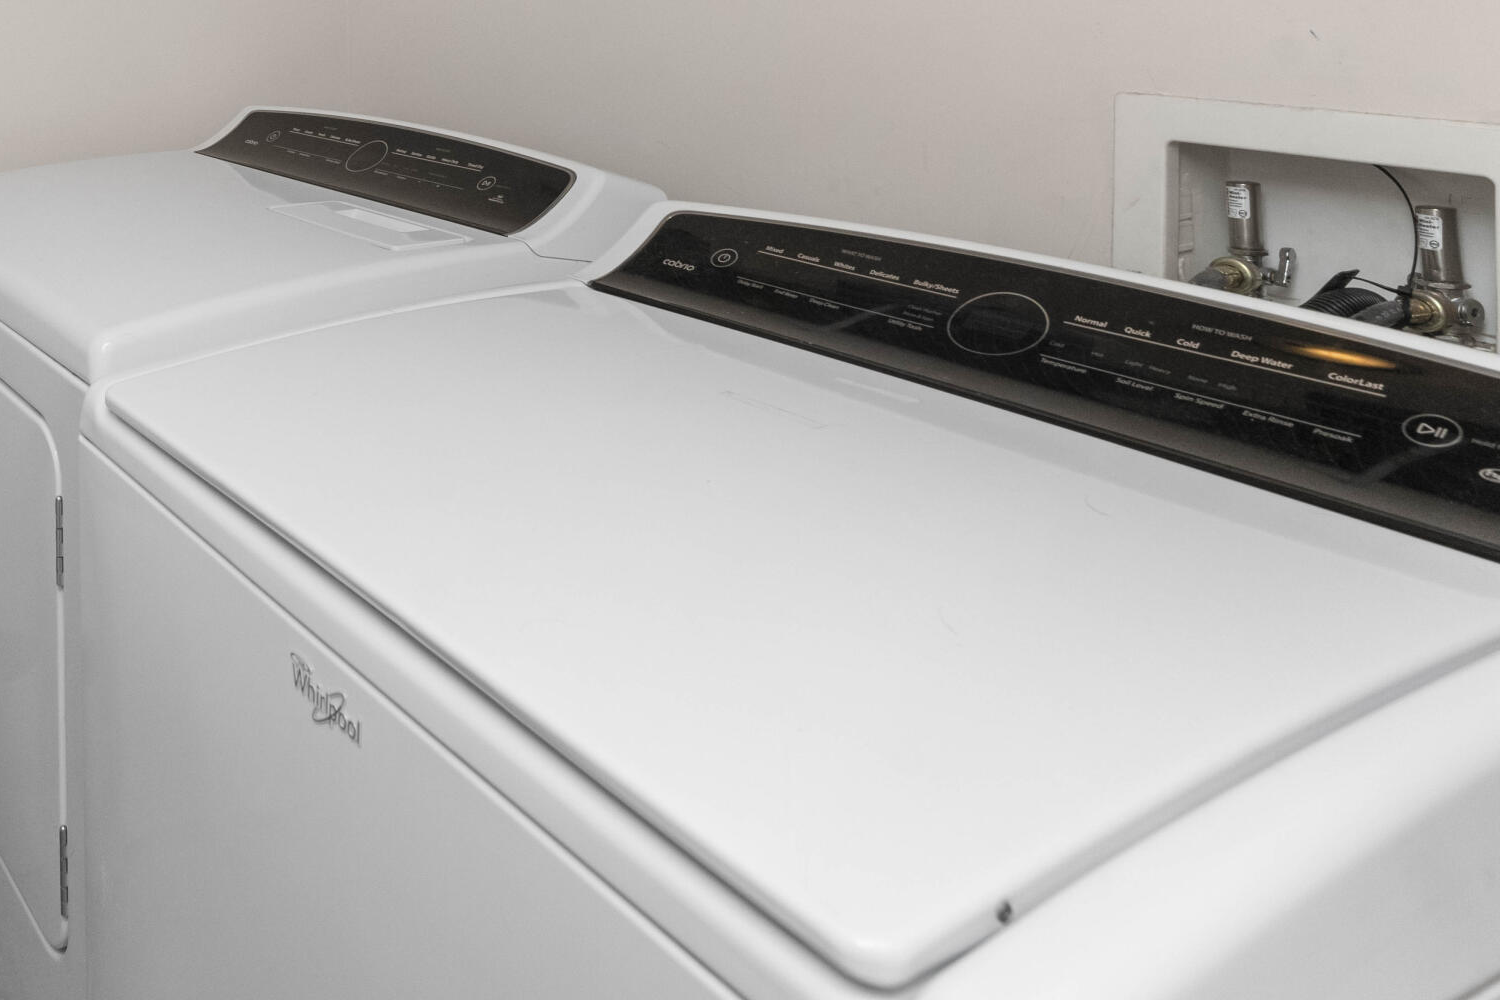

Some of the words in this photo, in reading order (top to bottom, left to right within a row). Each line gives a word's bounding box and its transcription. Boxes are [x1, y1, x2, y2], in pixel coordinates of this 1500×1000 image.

[662, 258, 695, 271] cabrio
[869, 269, 900, 280] Delicates
[913, 279, 960, 294] Bulky/Sheets
[1191, 323, 1213, 333] HOW
[1226, 331, 1253, 342] WASH
[1074, 315, 1109, 328] Normal
[1124, 326, 1151, 338] Quick
[1176, 338, 1201, 349] Cold
[1230, 350, 1260, 362] Deep
[1260, 356, 1294, 369] Water
[1327, 372, 1385, 390] ColorLast
[290, 654, 362, 746] Whirlpool
